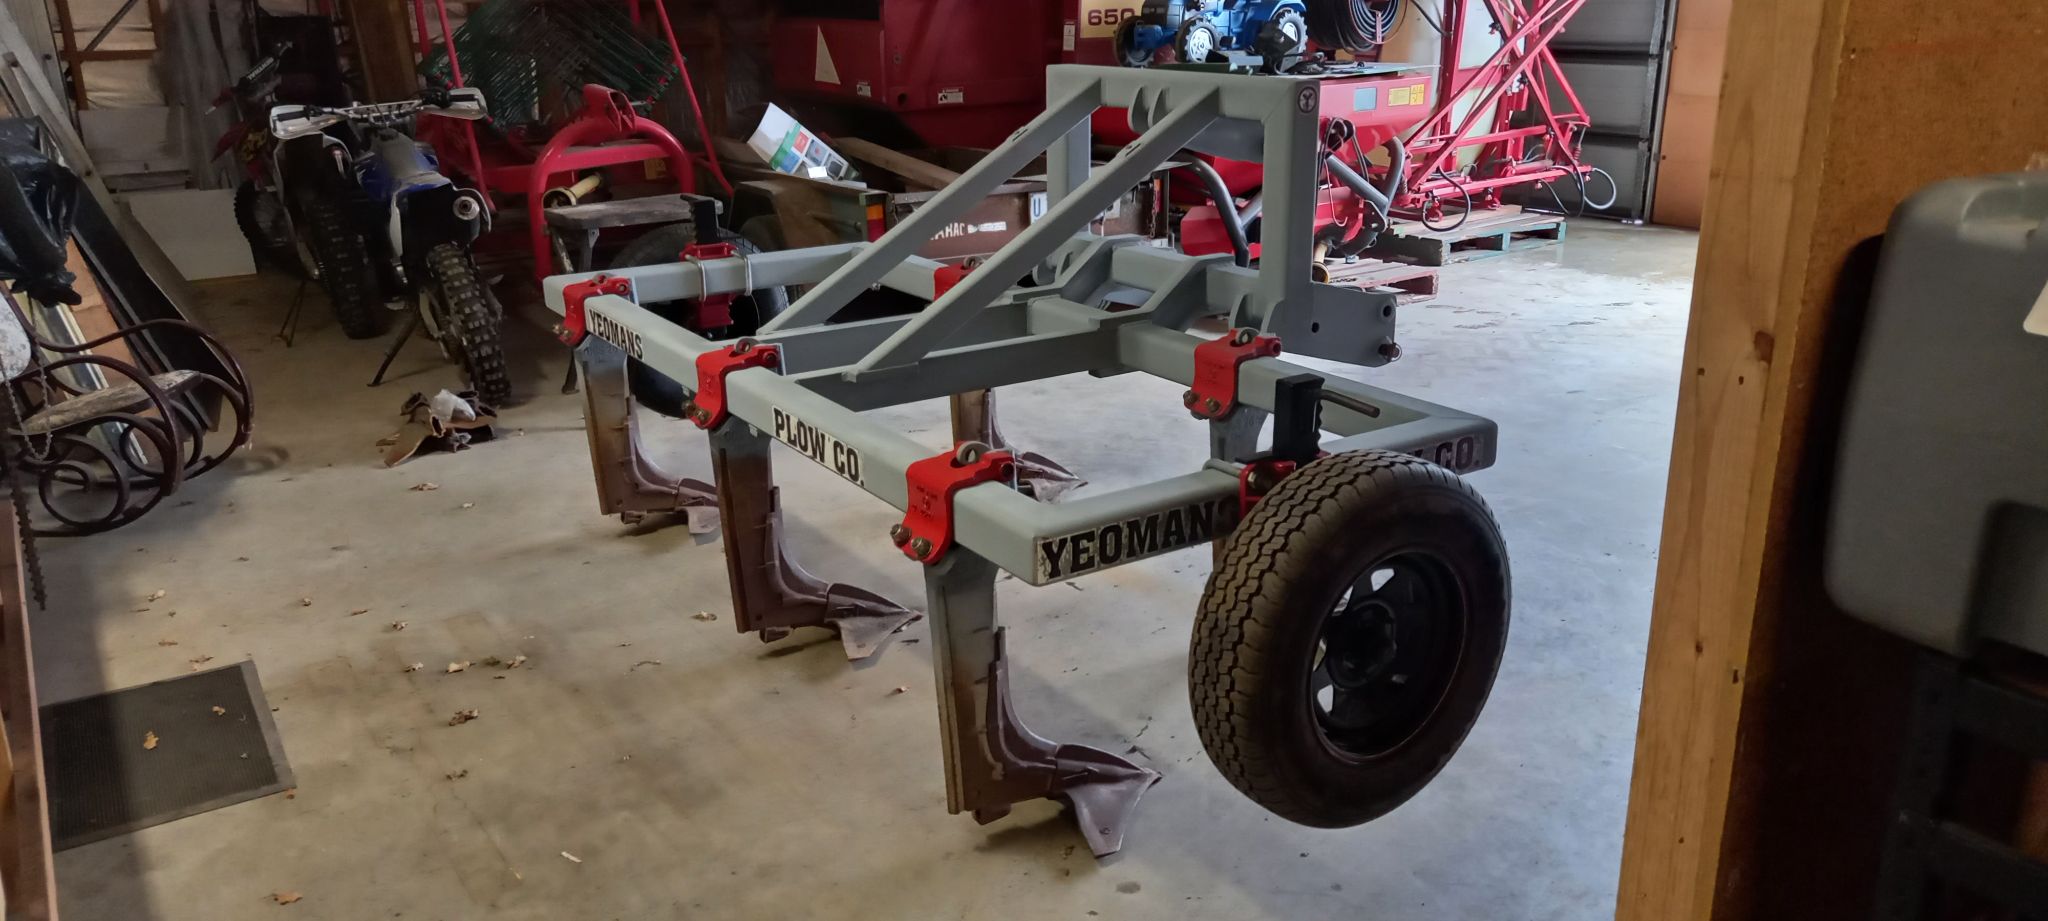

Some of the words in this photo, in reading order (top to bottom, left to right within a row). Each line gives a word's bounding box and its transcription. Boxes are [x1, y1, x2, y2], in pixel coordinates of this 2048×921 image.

[589, 308, 643, 360] YEOMANS
[773, 407, 826, 464] PLOW
[833, 440, 865, 487] CO.
